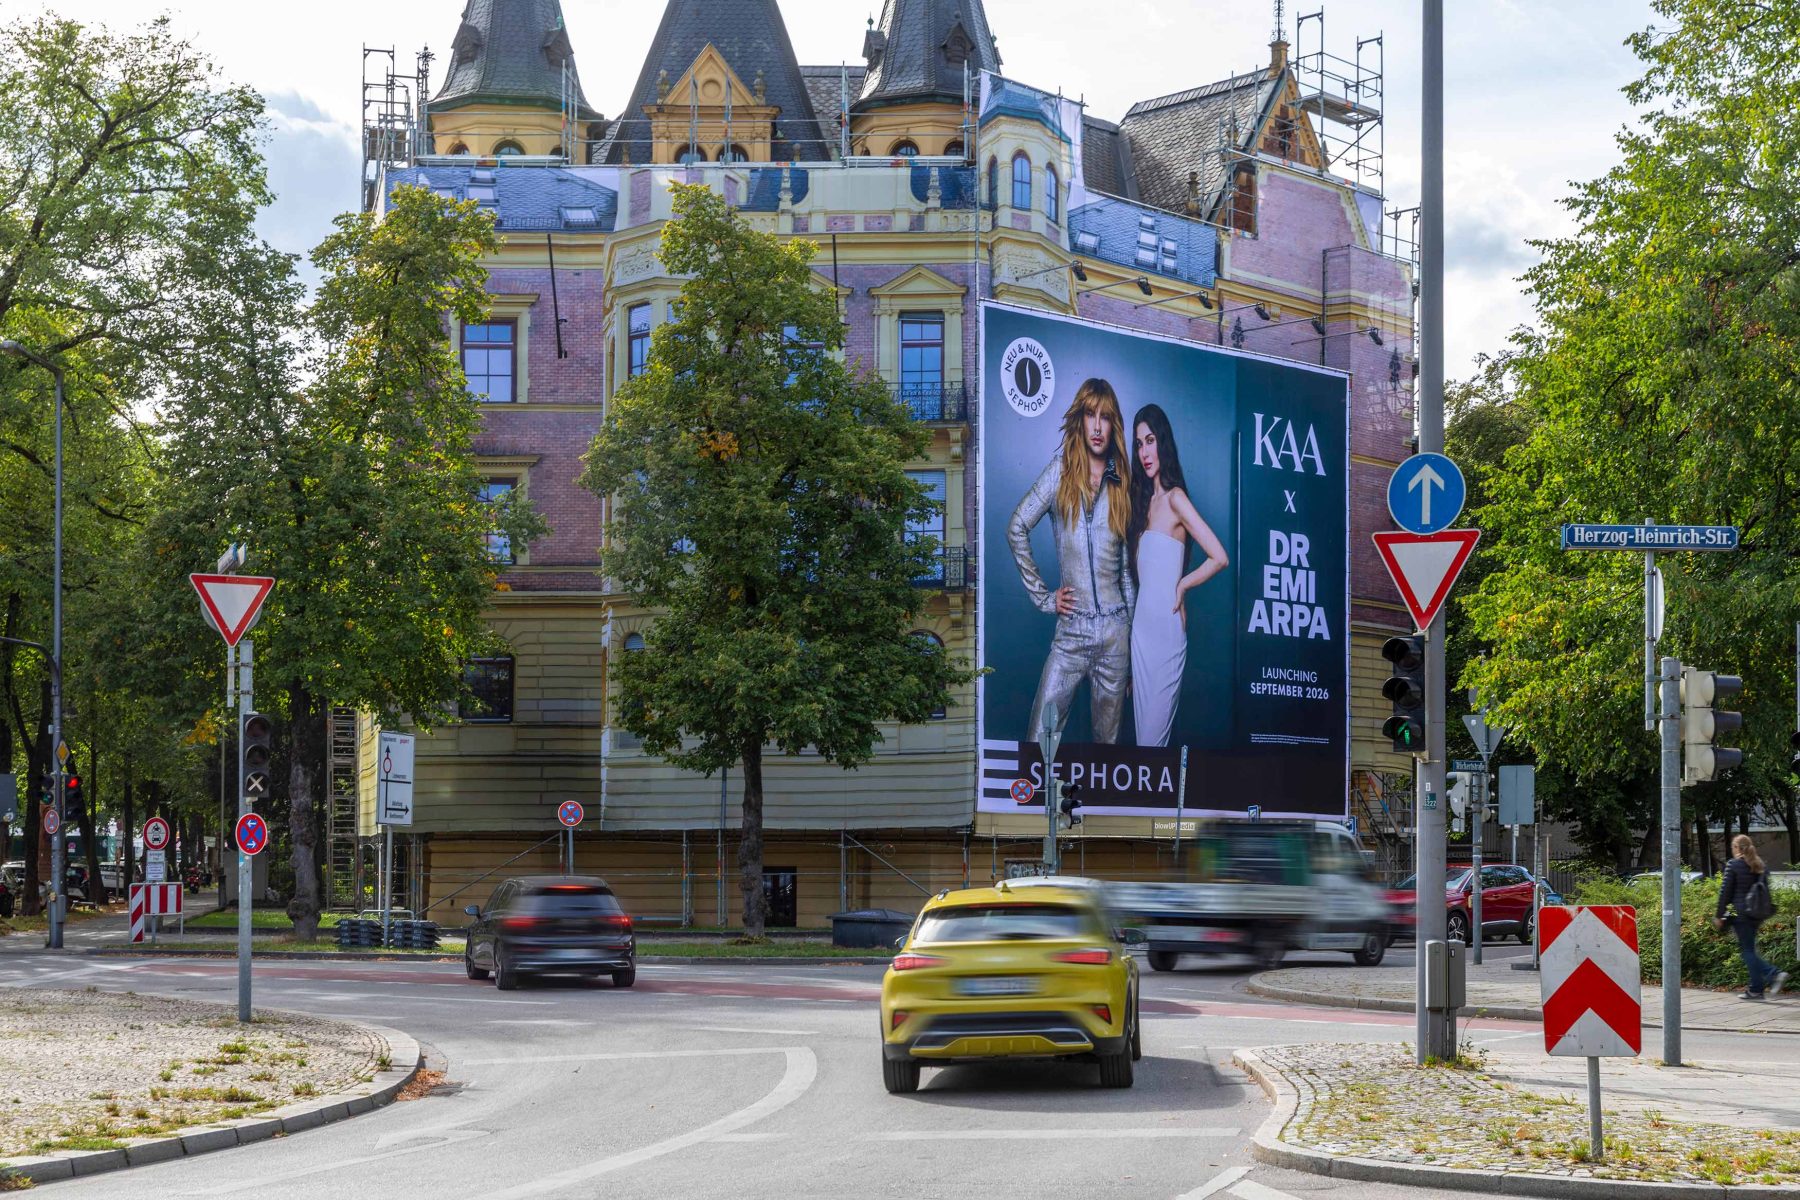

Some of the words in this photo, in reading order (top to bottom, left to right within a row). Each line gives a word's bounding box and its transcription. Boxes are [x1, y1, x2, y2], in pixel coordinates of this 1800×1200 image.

[1004, 348, 1018, 373] NEU
[1018, 343, 1025, 354] &
[1025, 342, 1044, 361] NUR
[1042, 362, 1051, 380] BEI
[1008, 388, 1049, 412] SEPHORA
[1253, 412, 1327, 476] KAA
[1269, 529, 1310, 568] DR
[1574, 527, 1732, 546] Herzog-Heinrich-Str.
[1263, 564, 1316, 604] EMI
[1247, 599, 1331, 641] ARPA
[1250, 682, 1303, 698] SEPTEMBER
[1305, 687, 1329, 700] 2026
[1262, 666, 1318, 683] LAUNCHING
